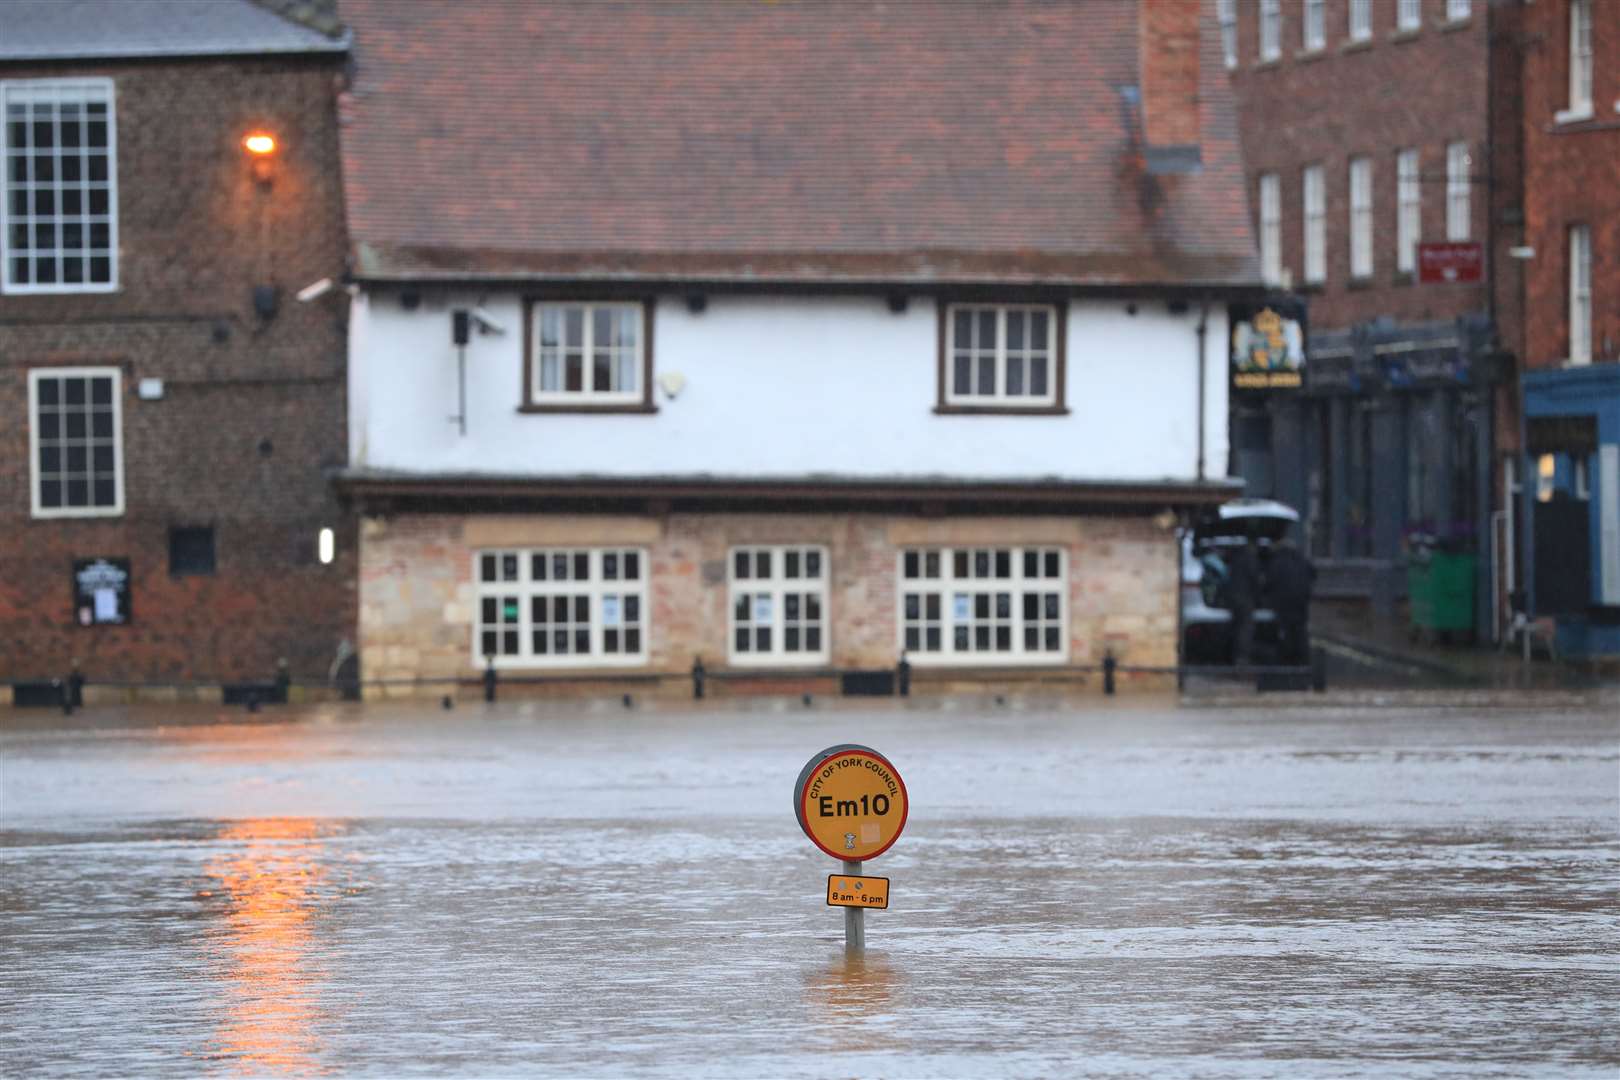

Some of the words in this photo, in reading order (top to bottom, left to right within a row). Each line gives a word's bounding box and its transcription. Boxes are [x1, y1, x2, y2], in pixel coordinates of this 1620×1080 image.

[810, 777, 824, 799] CITY
[822, 765, 835, 778] OF
[835, 758, 862, 769] YORK
[864, 760, 898, 797] COUNCIL
[819, 793, 890, 817] Em10
[832, 892, 838, 900] 8
[861, 894, 867, 903] 6
[869, 896, 883, 904] pm
